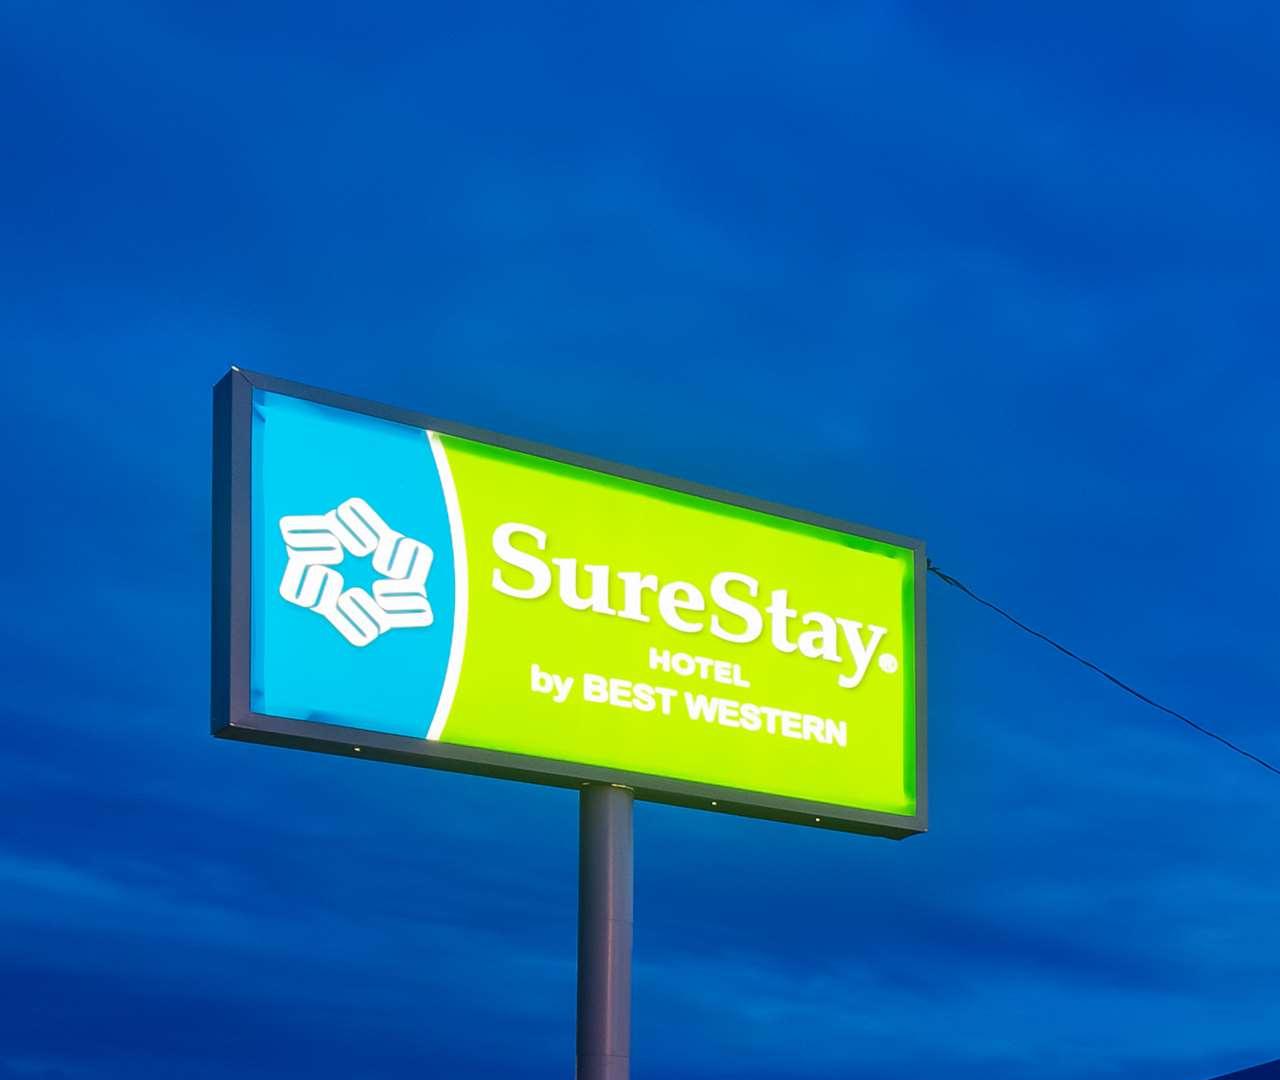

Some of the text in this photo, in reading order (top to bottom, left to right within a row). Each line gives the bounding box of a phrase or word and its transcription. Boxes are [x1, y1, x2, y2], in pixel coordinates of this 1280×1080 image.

[648, 647, 750, 688] HOTEL
[530, 664, 848, 747] by BEST WESTERN
